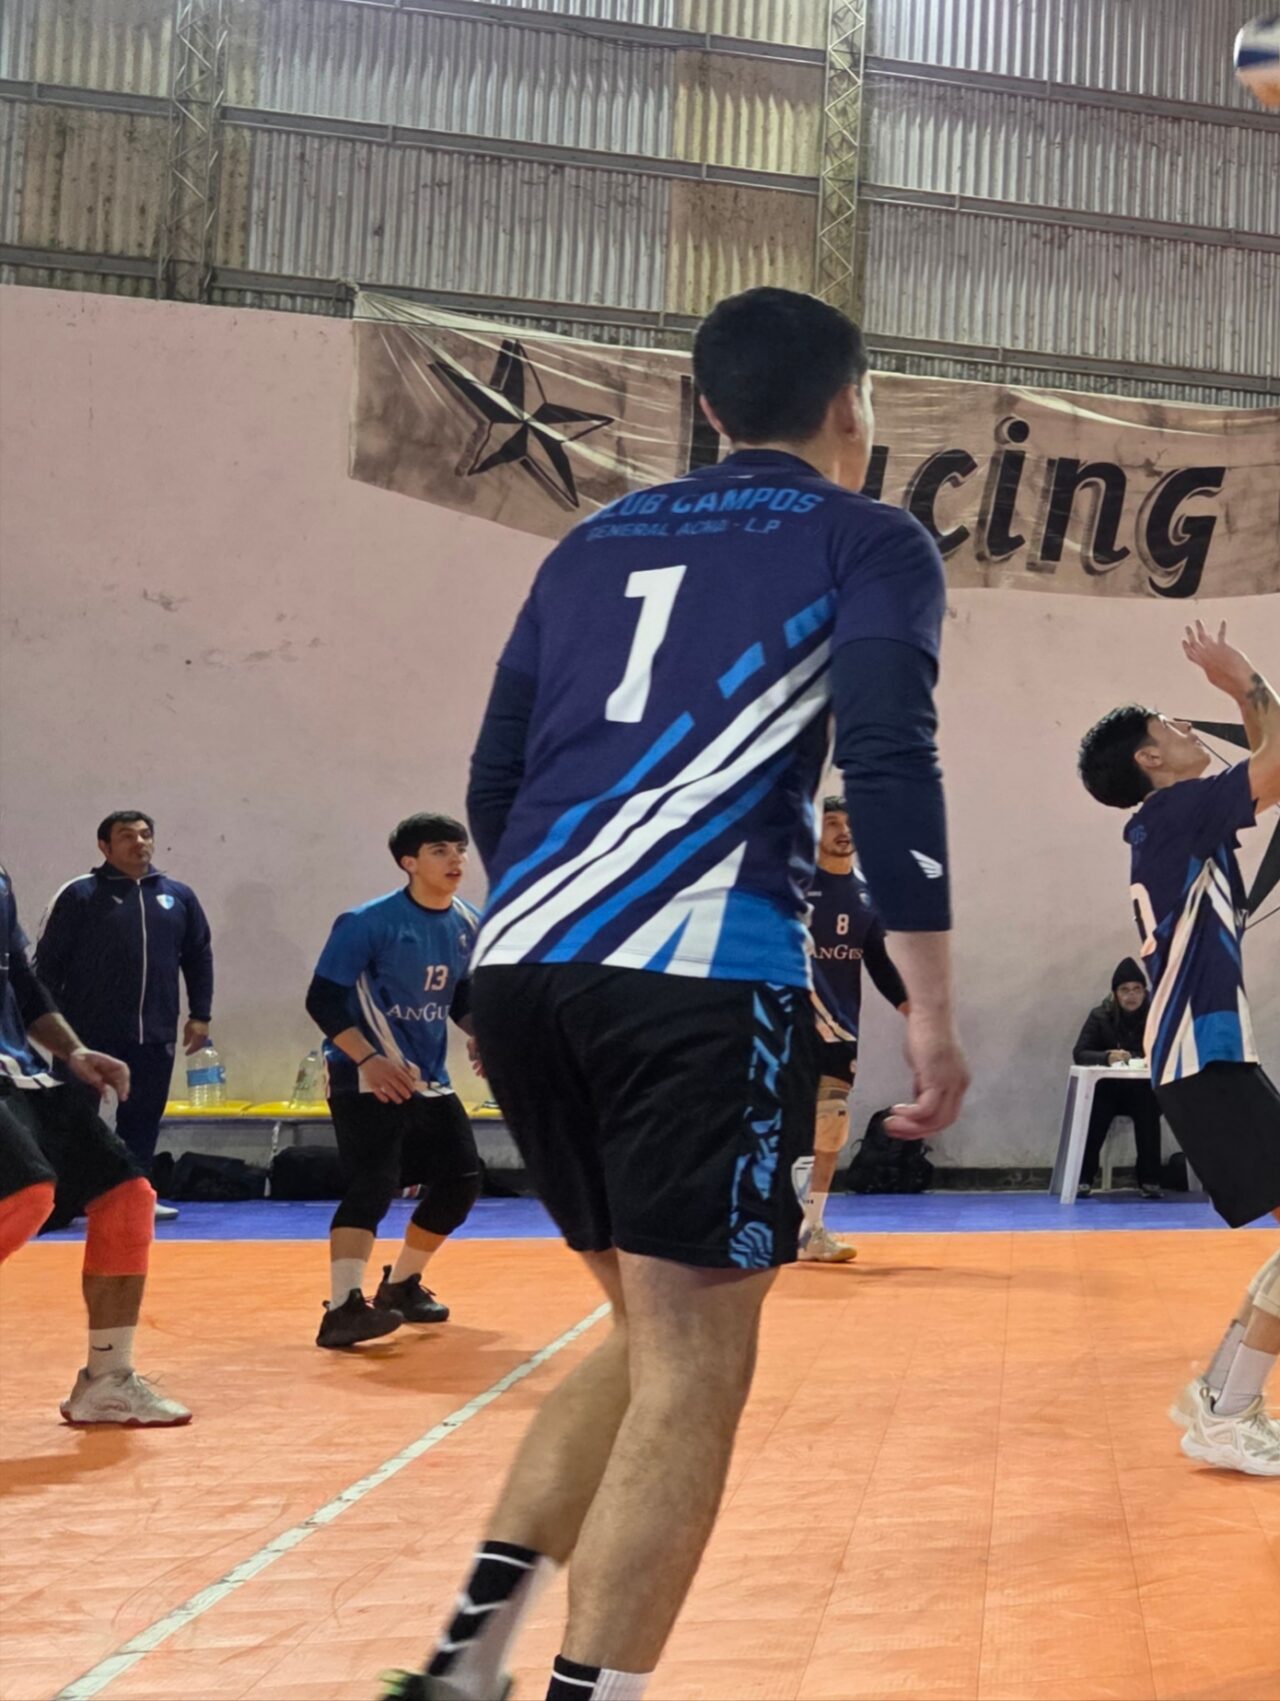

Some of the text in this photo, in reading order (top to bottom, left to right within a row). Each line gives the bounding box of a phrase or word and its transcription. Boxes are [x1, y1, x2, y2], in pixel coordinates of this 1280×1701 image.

[671, 487, 824, 513] CAMPOS
[603, 564, 687, 724] 1
[836, 913, 850, 936] 8
[423, 964, 449, 992] 13
[386, 1002, 451, 1023] ANGU
